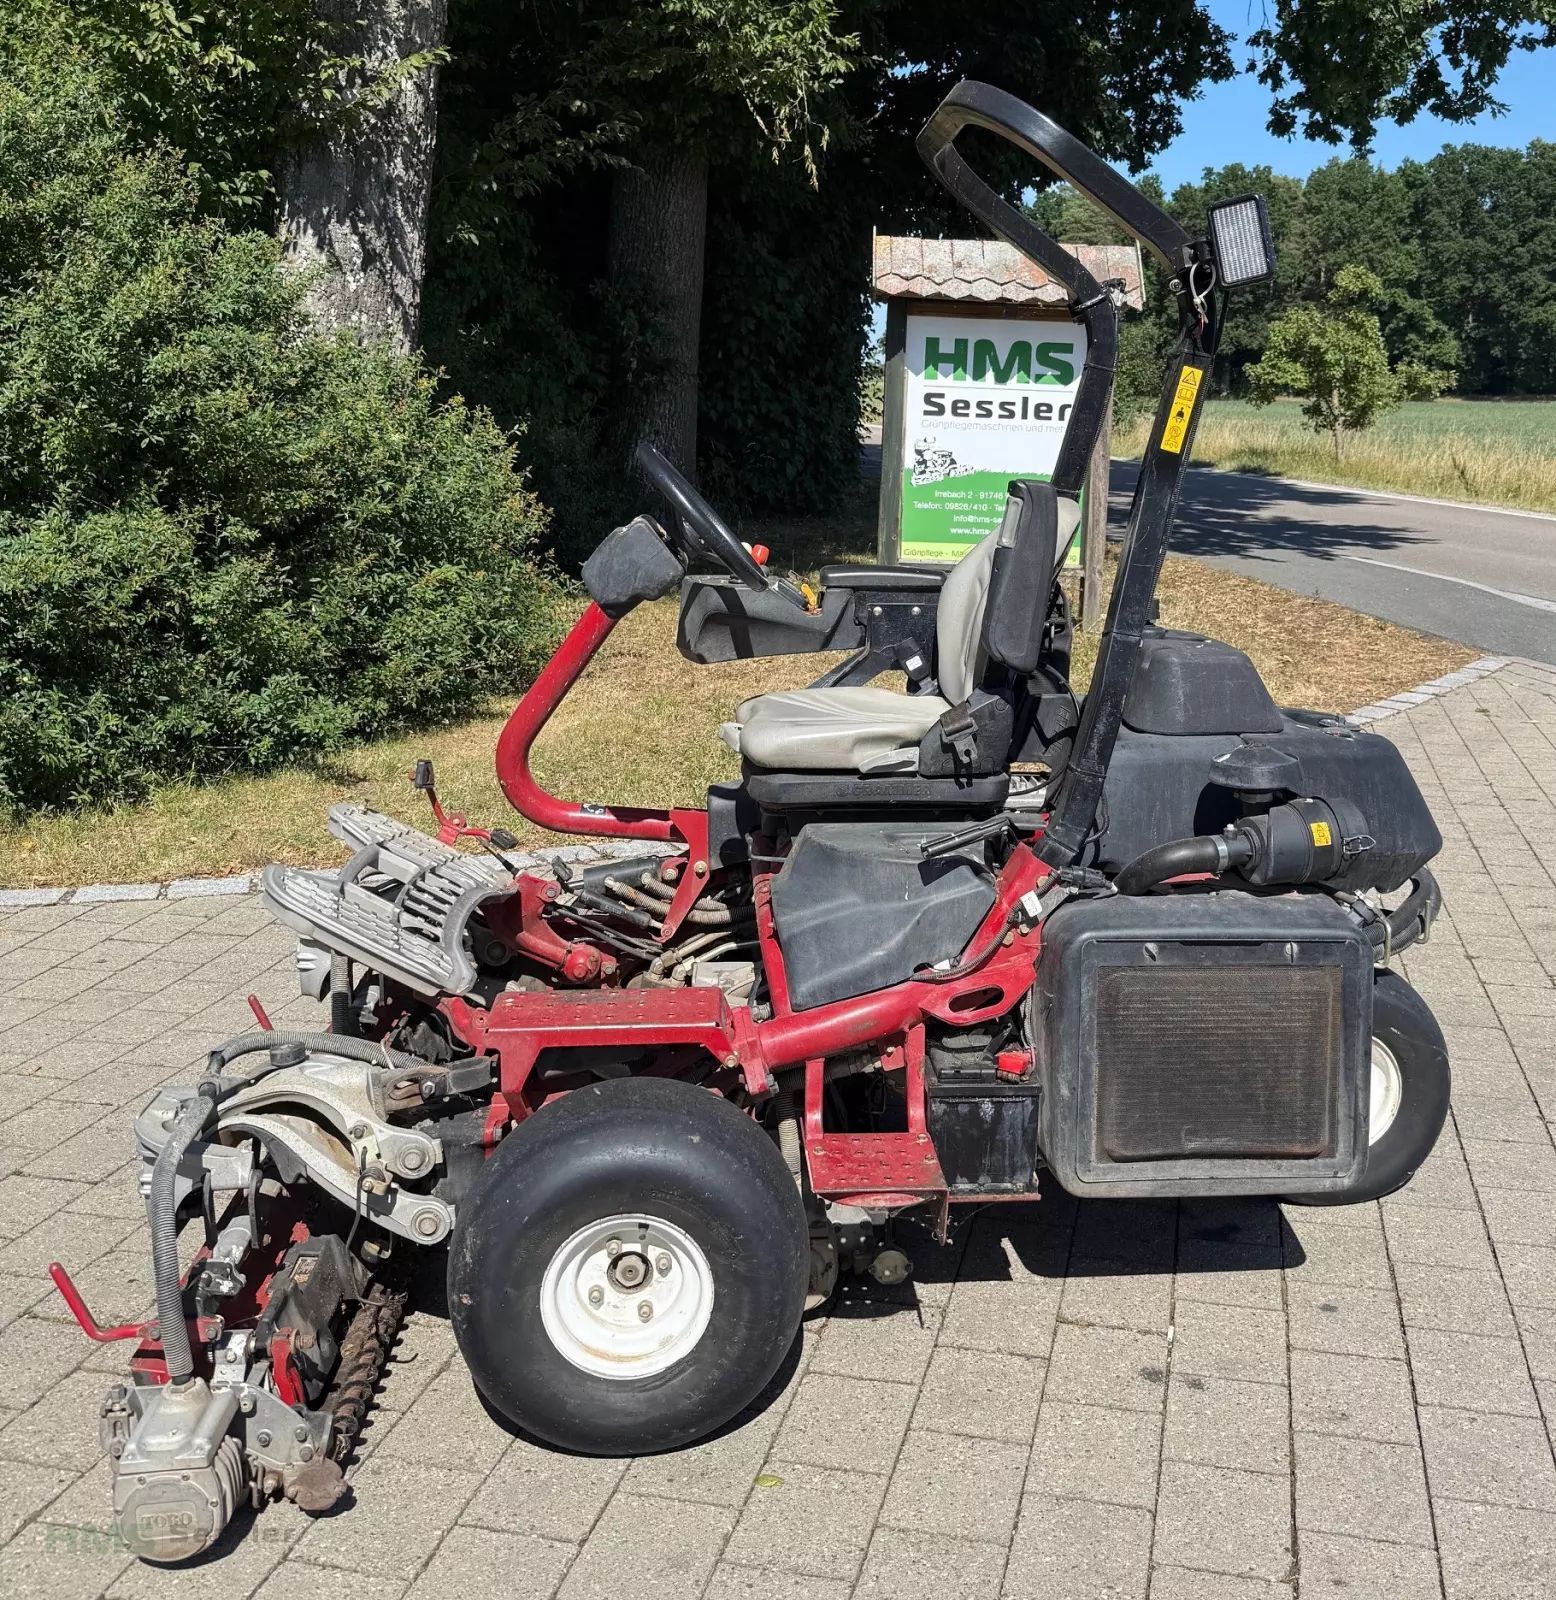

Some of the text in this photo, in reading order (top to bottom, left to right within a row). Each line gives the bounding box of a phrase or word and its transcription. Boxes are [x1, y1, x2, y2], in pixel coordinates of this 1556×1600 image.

[924, 337, 1075, 387] HMS
[923, 392, 1072, 421] Sessler
[921, 419, 1023, 432] Grünpflegemaschinen
[1025, 423, 1044, 433] und
[934, 489, 966, 499] Irrebach
[967, 490, 973, 499] 2
[979, 491, 1004, 500] 91746
[913, 500, 942, 510] Telefon:
[949, 527, 991, 535] www.hms-
[904, 548, 944, 558] Grünpflege
[140, 1511, 193, 1530] TORO
